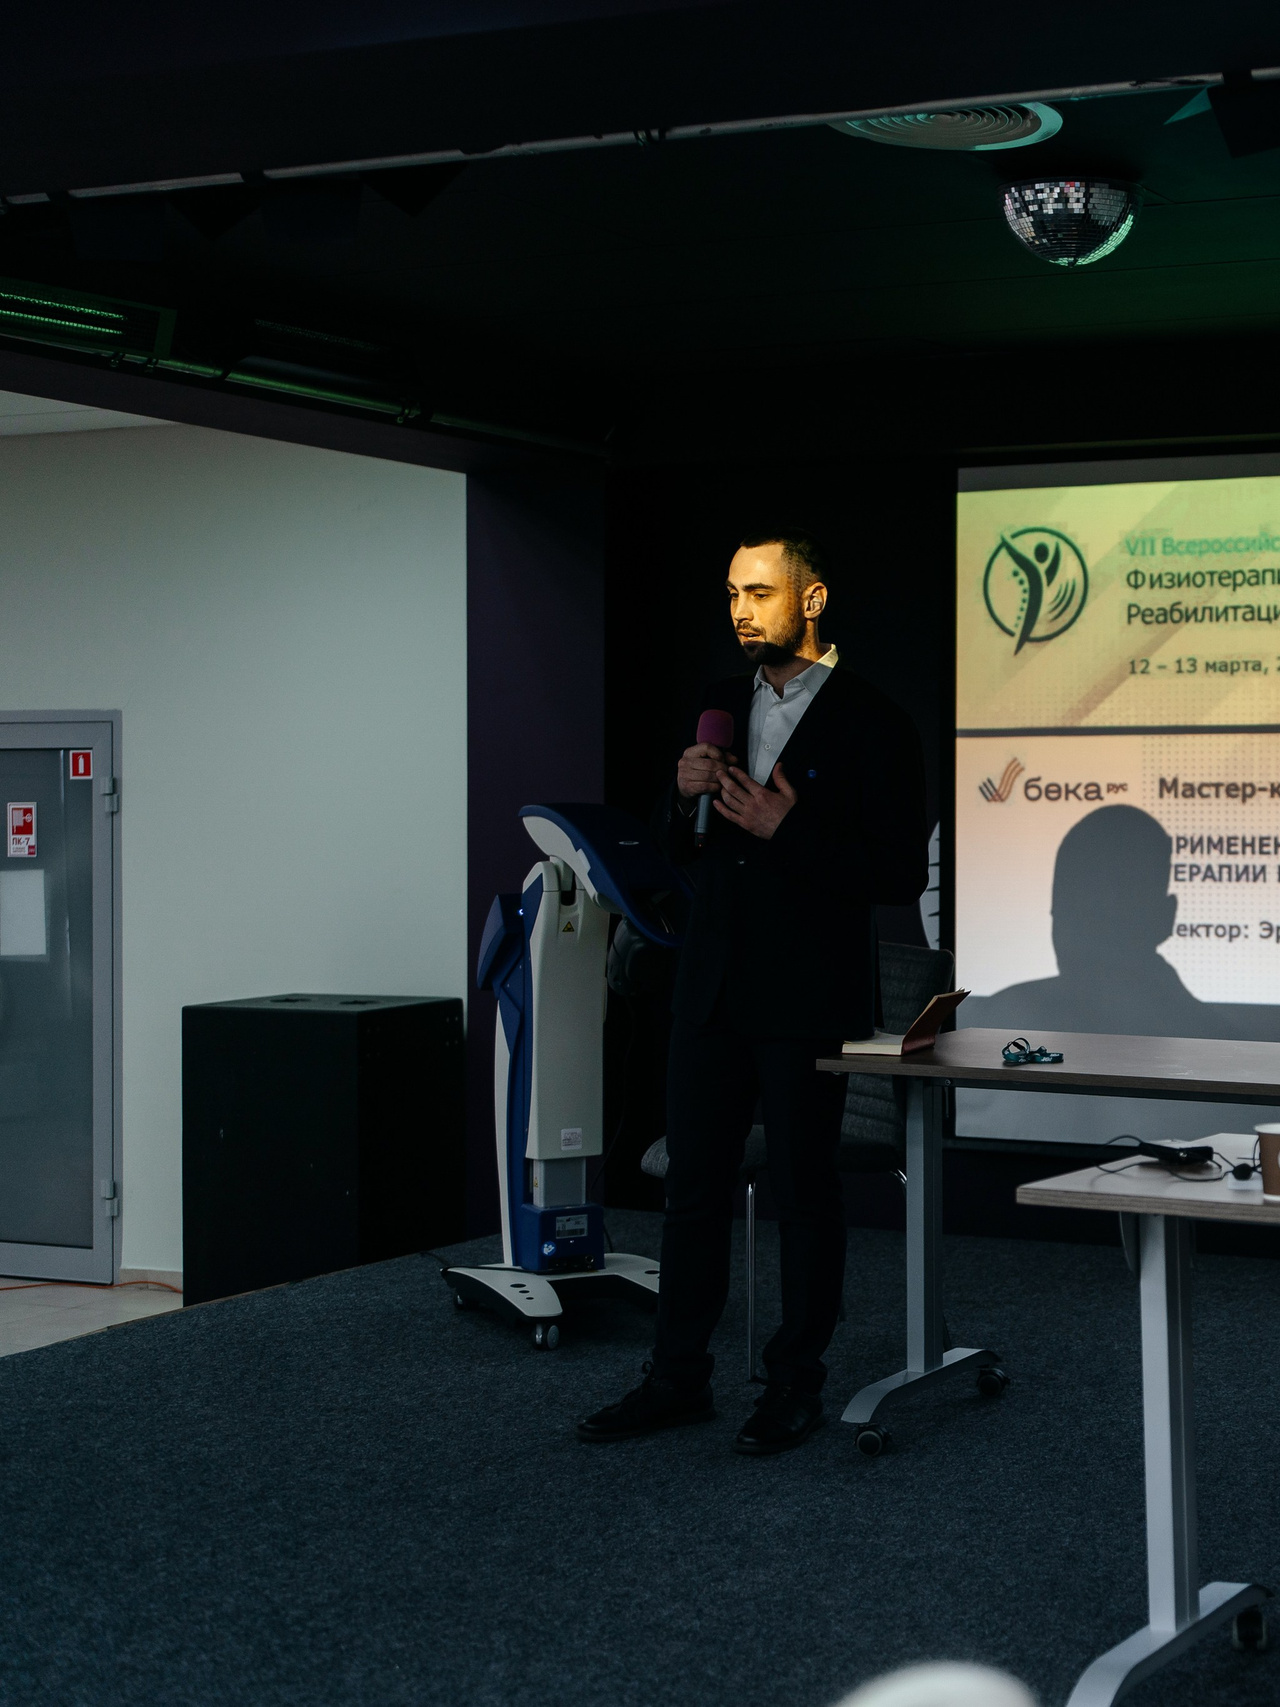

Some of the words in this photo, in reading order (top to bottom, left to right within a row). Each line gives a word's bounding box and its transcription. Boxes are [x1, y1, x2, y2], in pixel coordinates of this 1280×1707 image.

[1125, 536, 1156, 556] VII
[1129, 658, 1150, 674] 12
[1175, 657, 1198, 674] 13
[1205, 657, 1269, 676] марта,
[12, 837, 31, 846] ПК-7
[1173, 863, 1268, 883] ЕРАПИИ
[1175, 922, 1249, 943] ектор:
